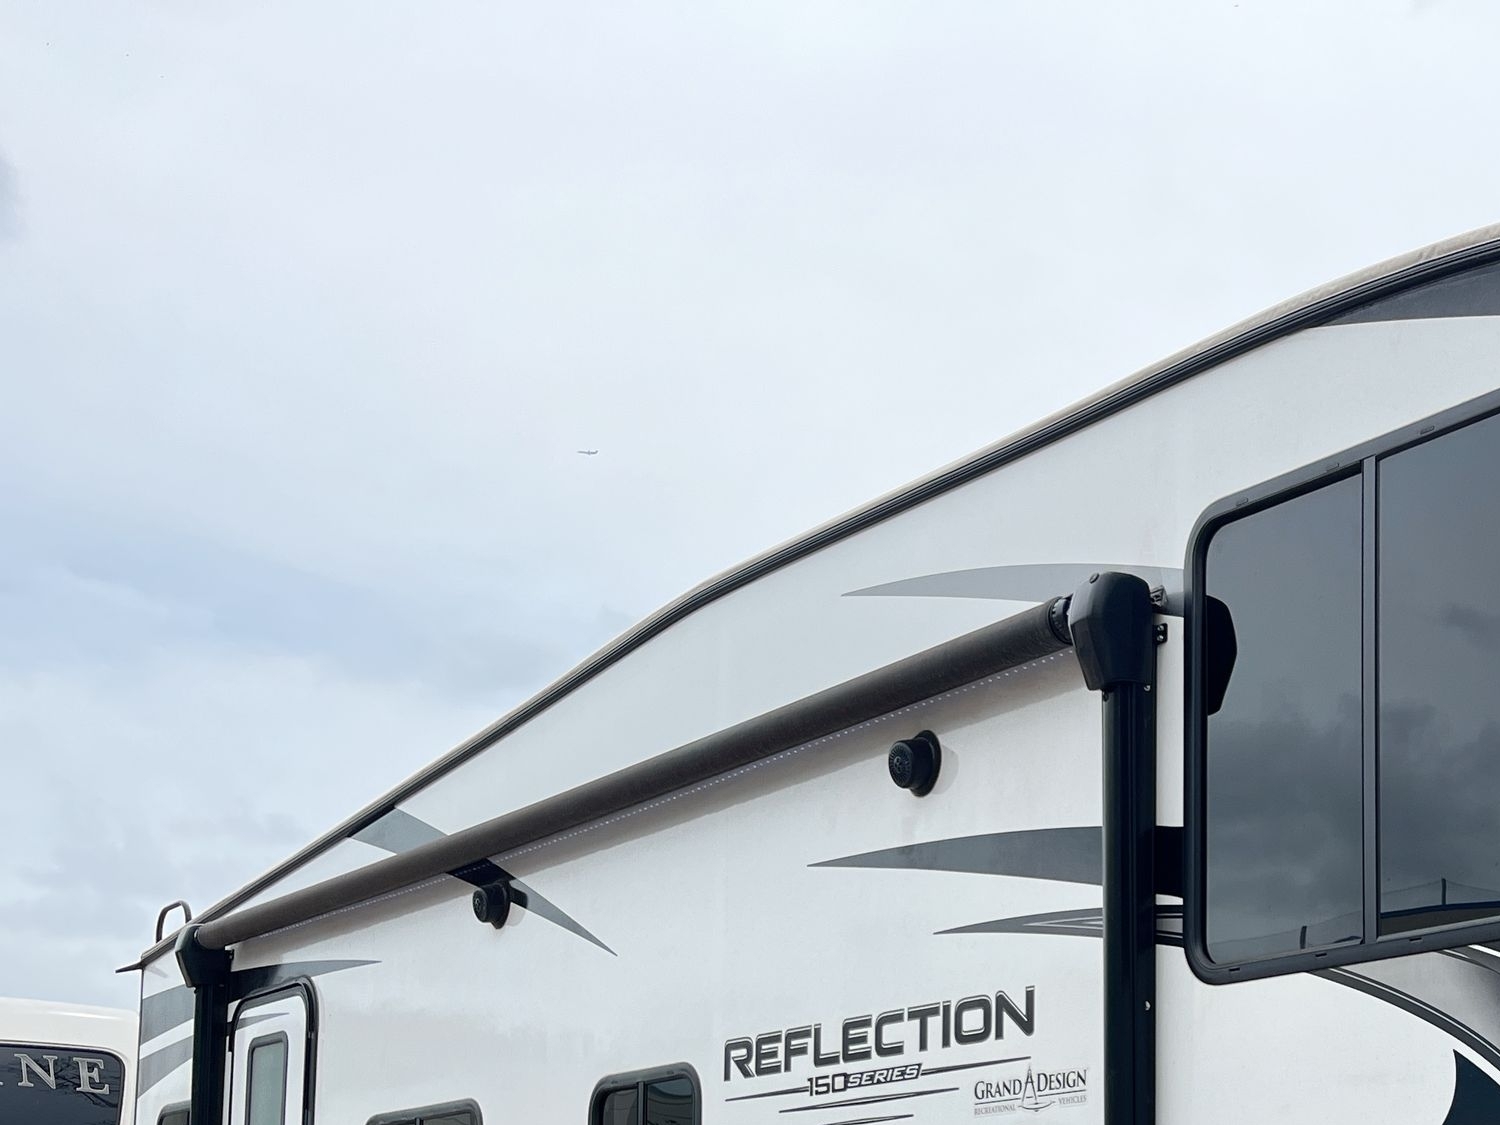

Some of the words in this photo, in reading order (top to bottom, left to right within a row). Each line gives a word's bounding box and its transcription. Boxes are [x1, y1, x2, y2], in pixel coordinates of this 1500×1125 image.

[724, 985, 1035, 1082] REFLECTION
[0, 1053, 110, 1095] NE
[807, 1072, 848, 1097] 150
[847, 1064, 921, 1087] SERIES
